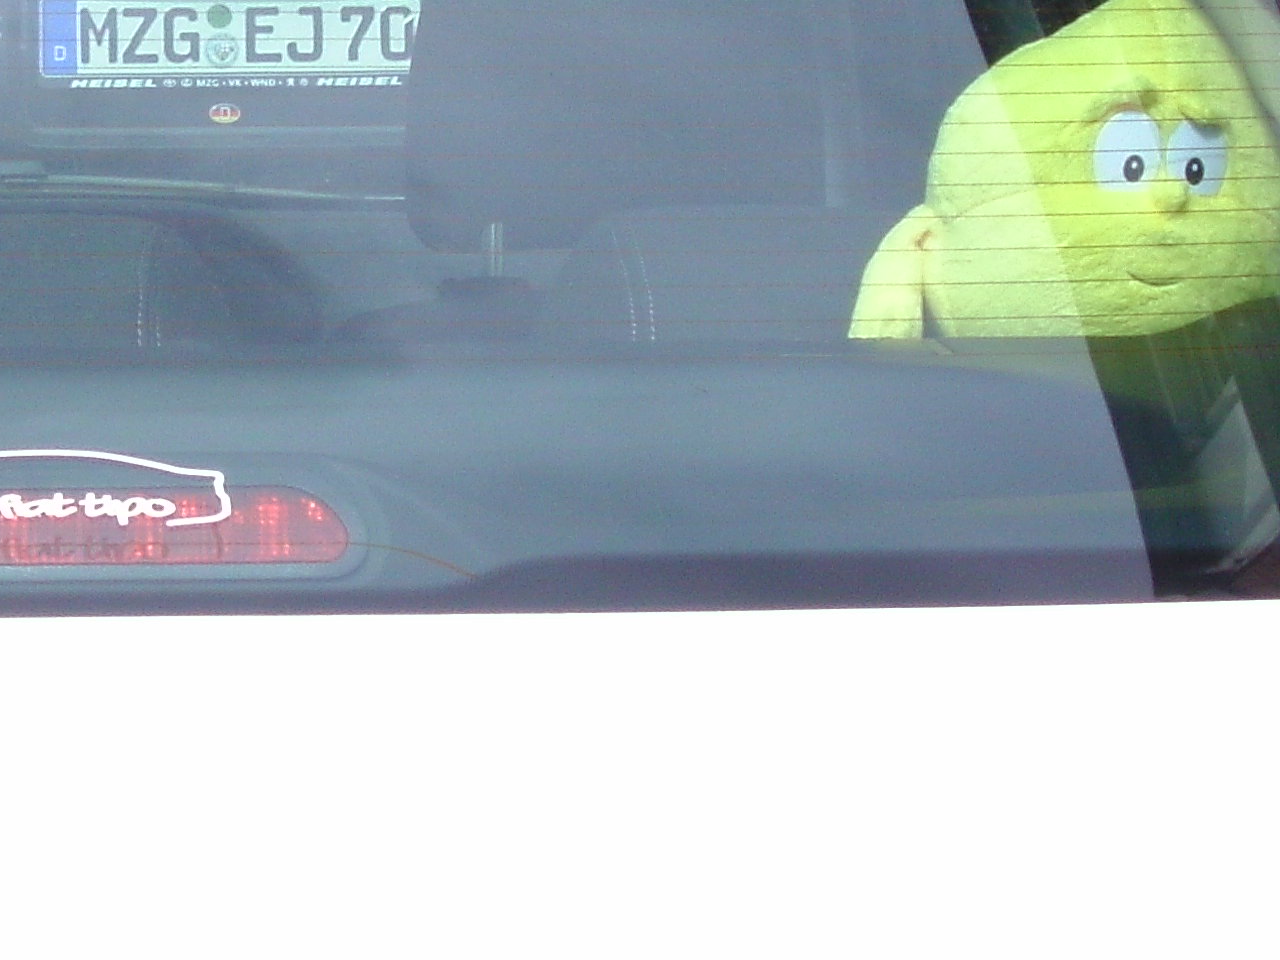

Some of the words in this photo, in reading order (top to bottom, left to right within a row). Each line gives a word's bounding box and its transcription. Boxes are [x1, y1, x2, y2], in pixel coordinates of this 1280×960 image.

[79, 7, 200, 64] MZG
[245, 6, 320, 63] EJ
[54, 46, 66, 61] D
